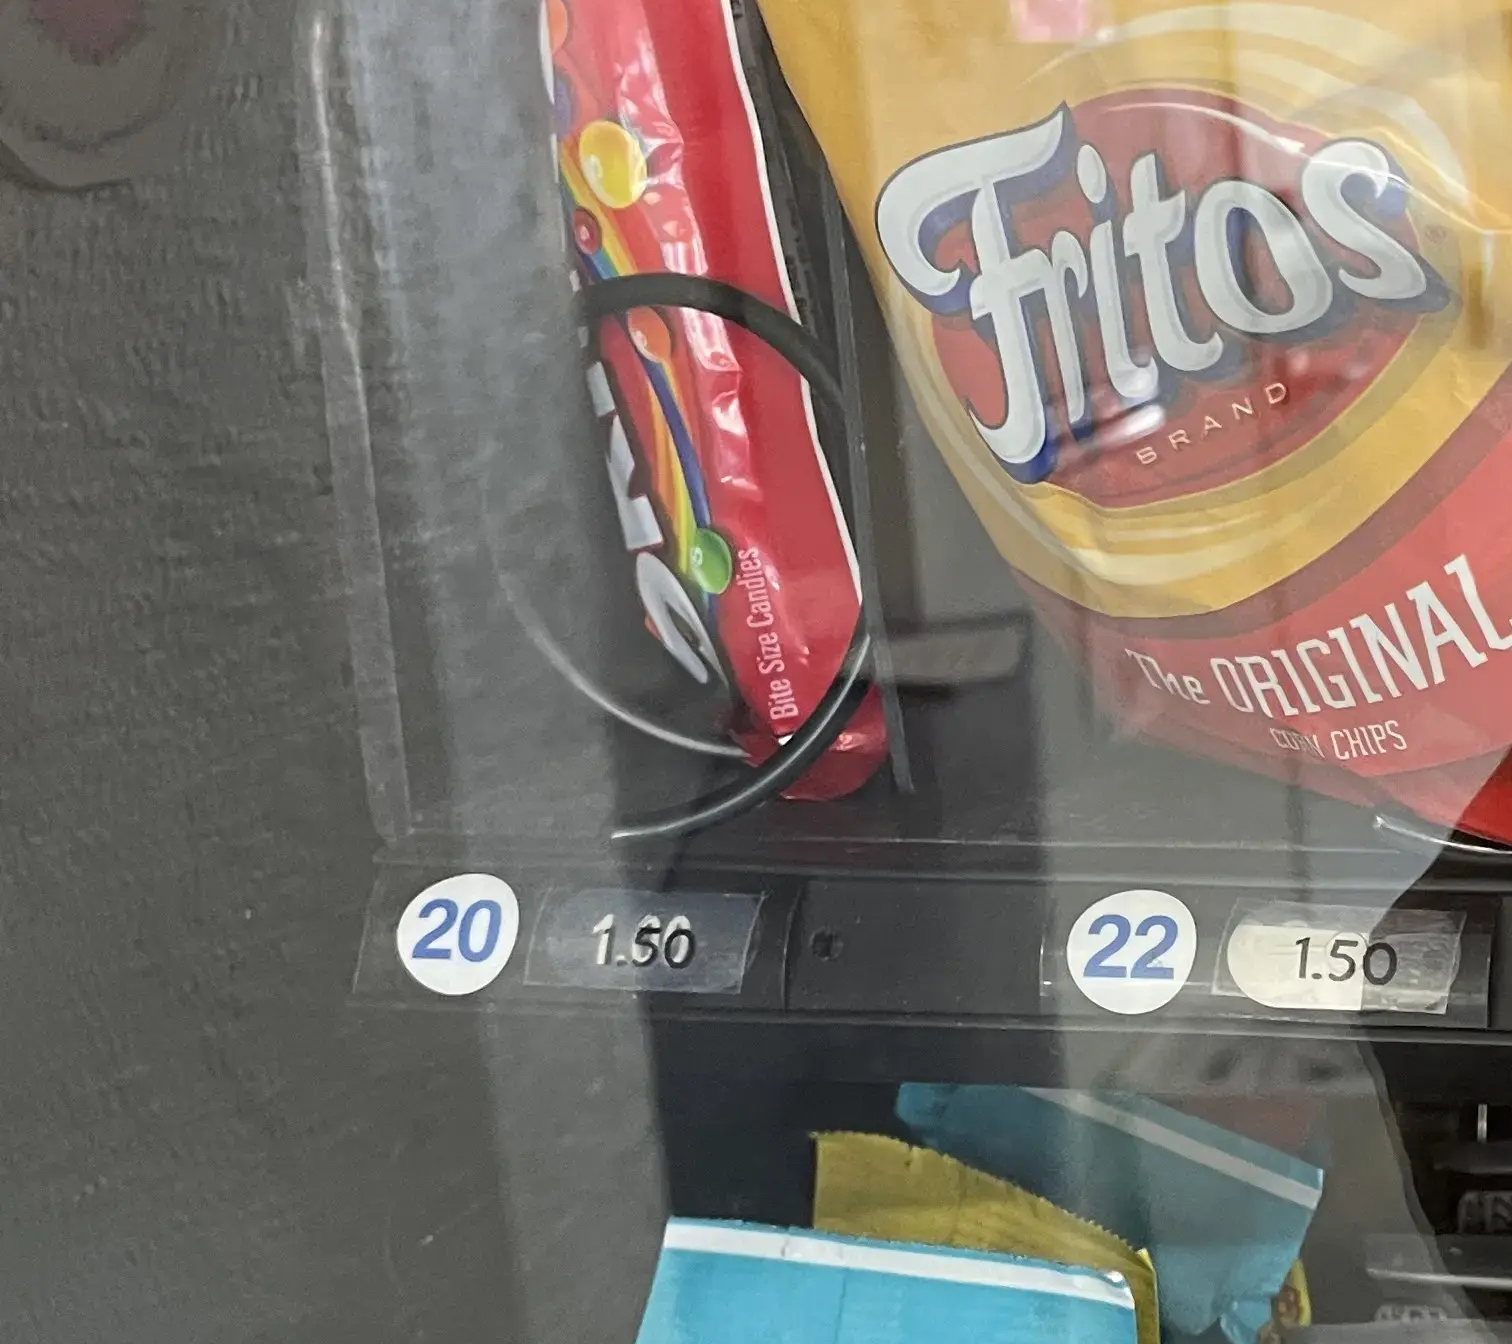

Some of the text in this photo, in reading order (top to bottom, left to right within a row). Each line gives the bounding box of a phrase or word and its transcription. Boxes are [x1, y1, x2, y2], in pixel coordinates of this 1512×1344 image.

[876, 103, 1440, 471] Fritos
[1137, 380, 1288, 466] BRAND
[733, 546, 799, 720] Bite Size Candies
[1124, 648, 1211, 705] The
[1331, 719, 1407, 761] CHIPS
[411, 898, 502, 964] 20
[593, 913, 697, 970] 1.50
[1082, 913, 1180, 981] 22
[1294, 936, 1398, 987] 1.50
